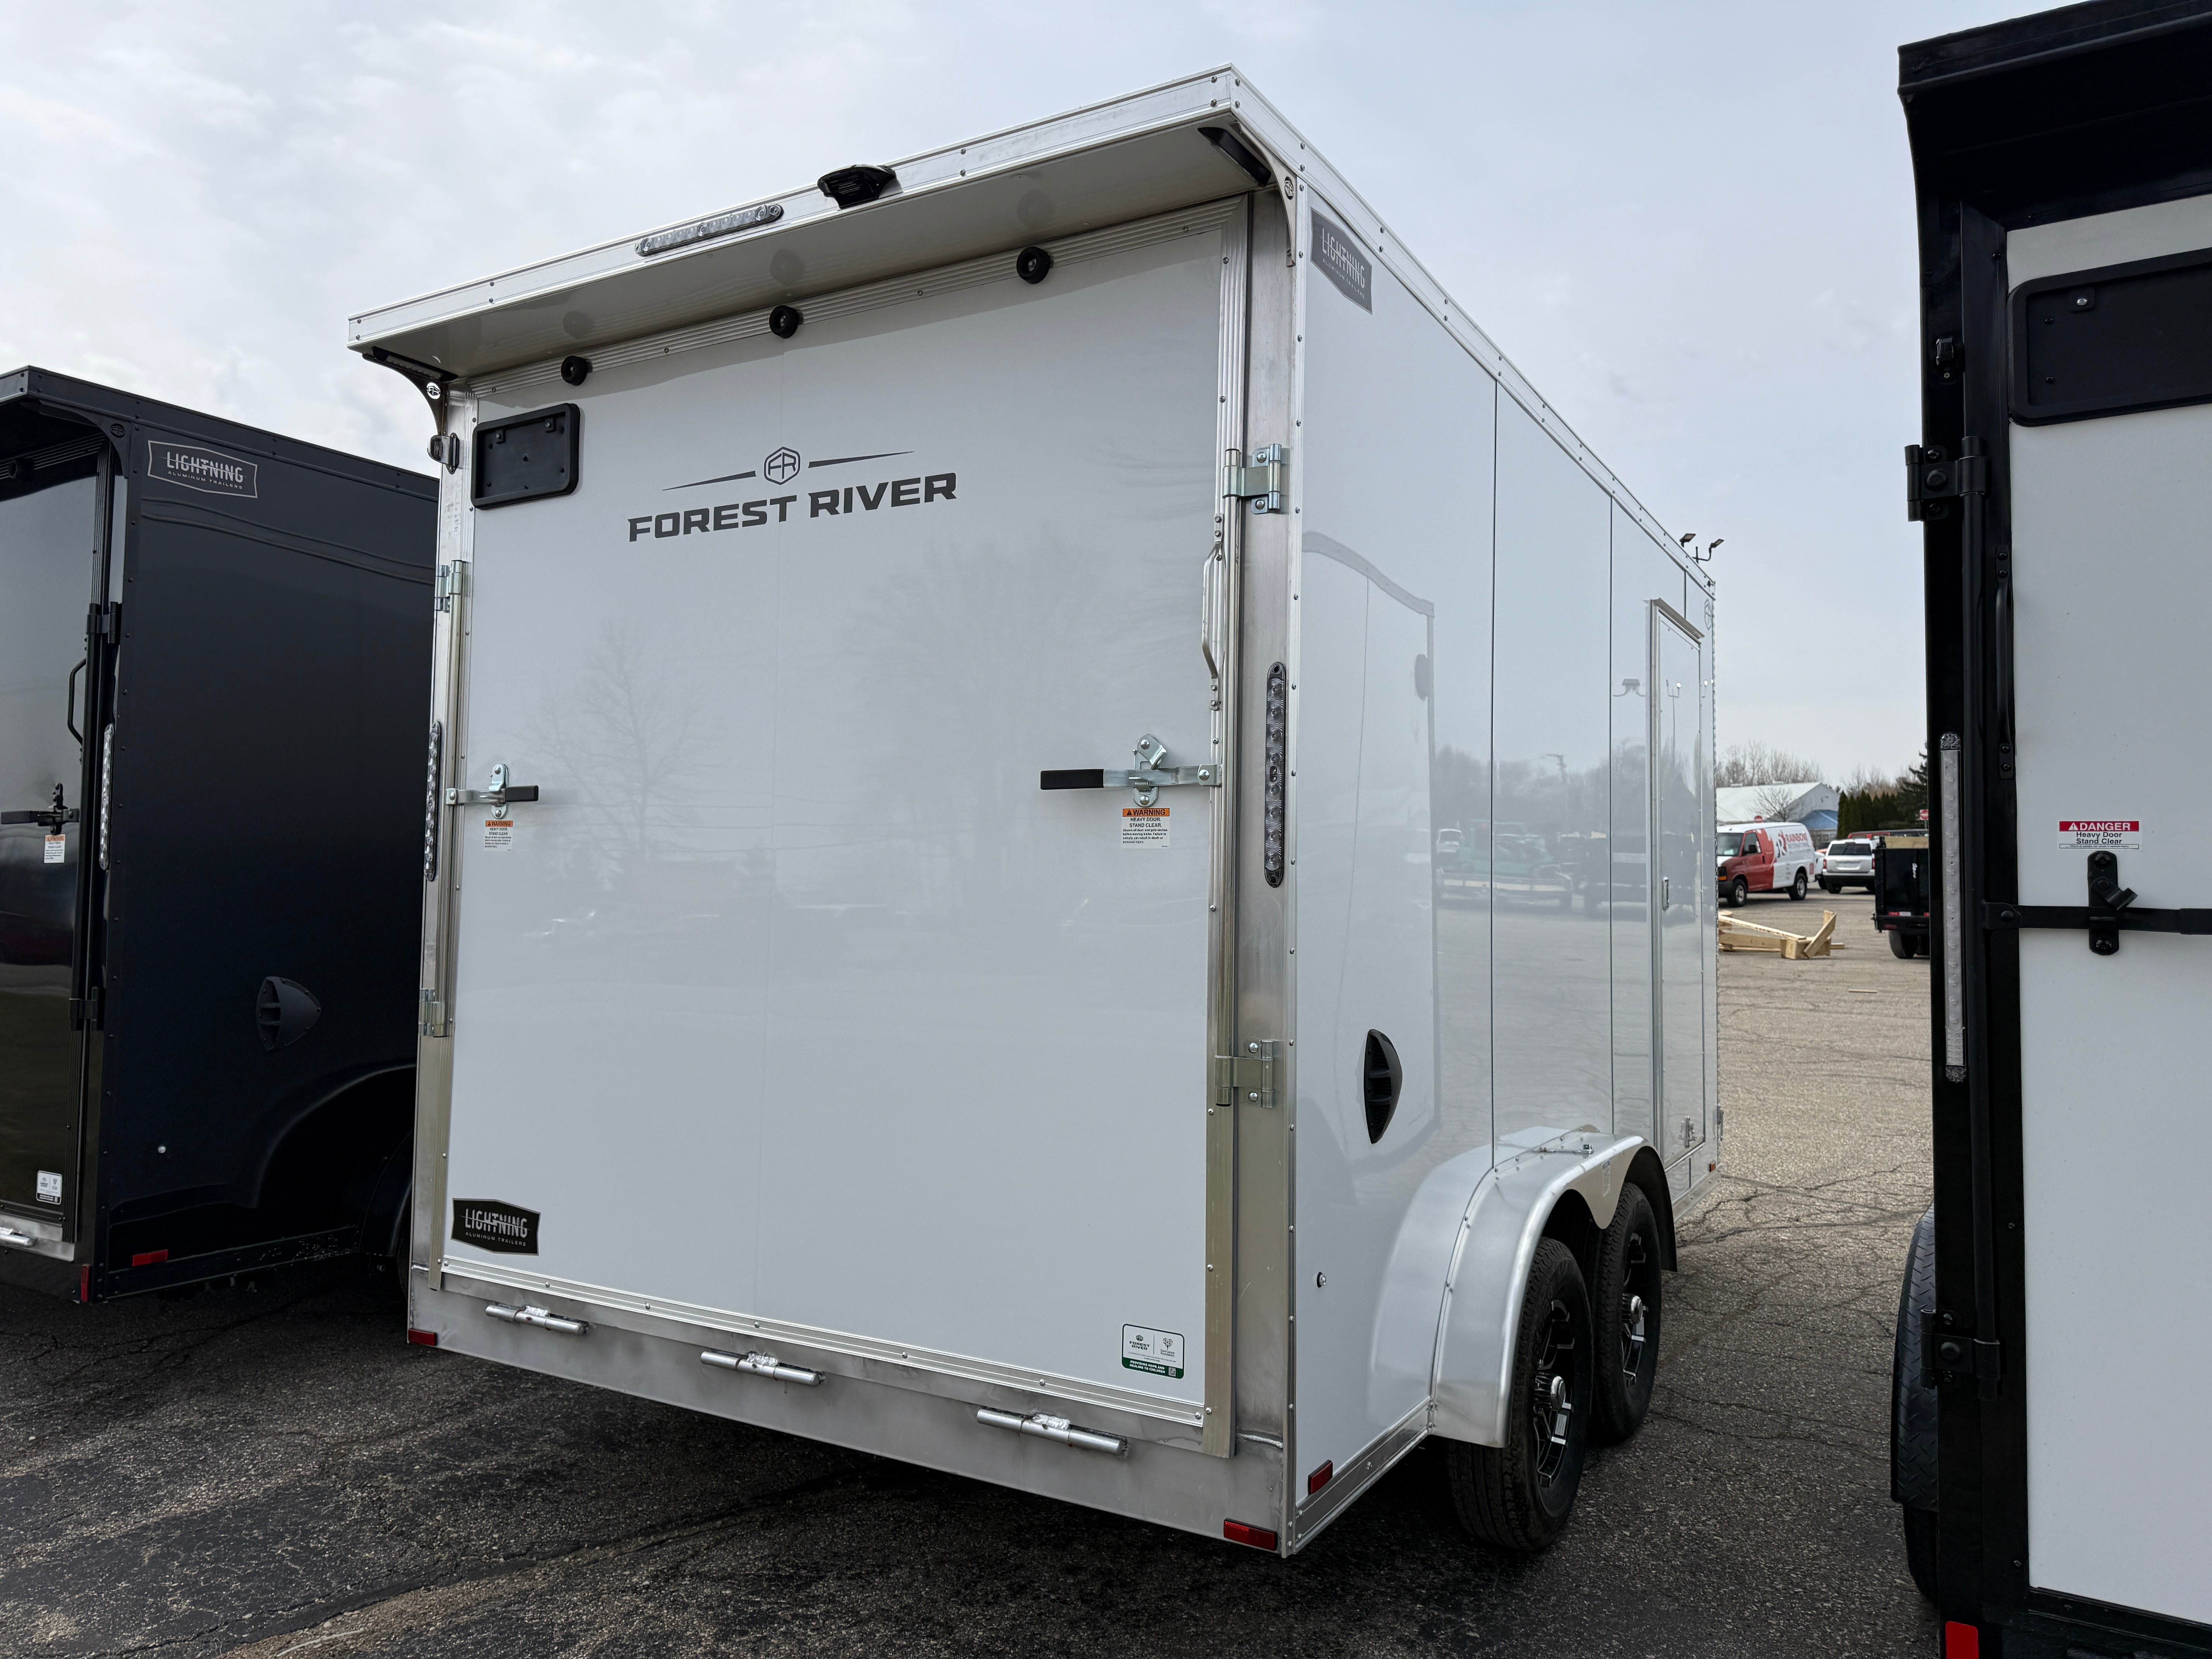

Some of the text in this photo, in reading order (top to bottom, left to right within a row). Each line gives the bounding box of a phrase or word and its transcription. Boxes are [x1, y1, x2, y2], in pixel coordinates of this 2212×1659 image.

[1322, 228, 1365, 289] LIGHTNING
[167, 451, 244, 483] LIGHTNING
[168, 471, 242, 489] ALUMINUM TRAILERS
[627, 472, 957, 542] FOREST RIVER
[2080, 823, 2130, 831] DANGER
[465, 1208, 527, 1238] LIGHTNING
[465, 1231, 526, 1247] ALUMINUM TRAILERS
